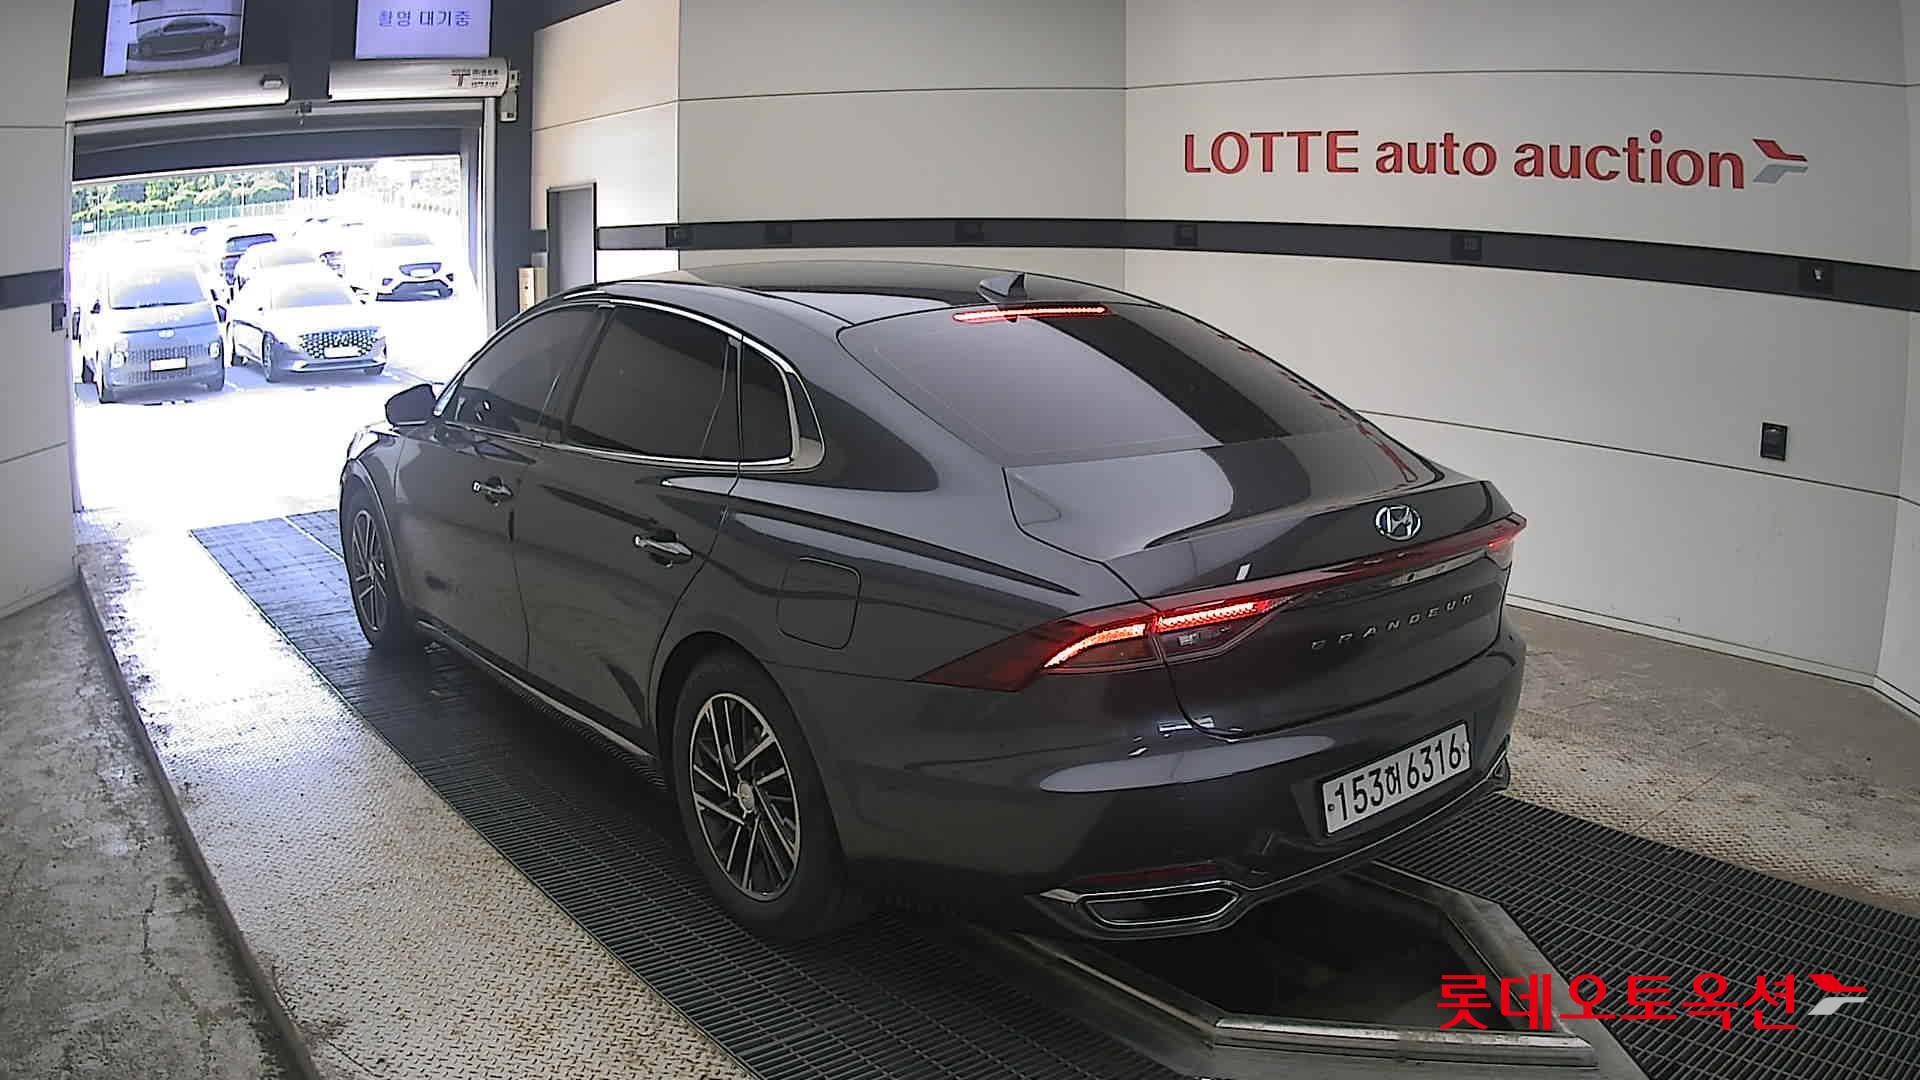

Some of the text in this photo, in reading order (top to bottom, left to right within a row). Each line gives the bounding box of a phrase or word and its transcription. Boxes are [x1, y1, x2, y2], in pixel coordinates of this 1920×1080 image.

[419, 9, 473, 27] 대기중
[1184, 129, 1745, 189] LOTTE auto auction
[1311, 593, 1473, 650] GRANDEUR
